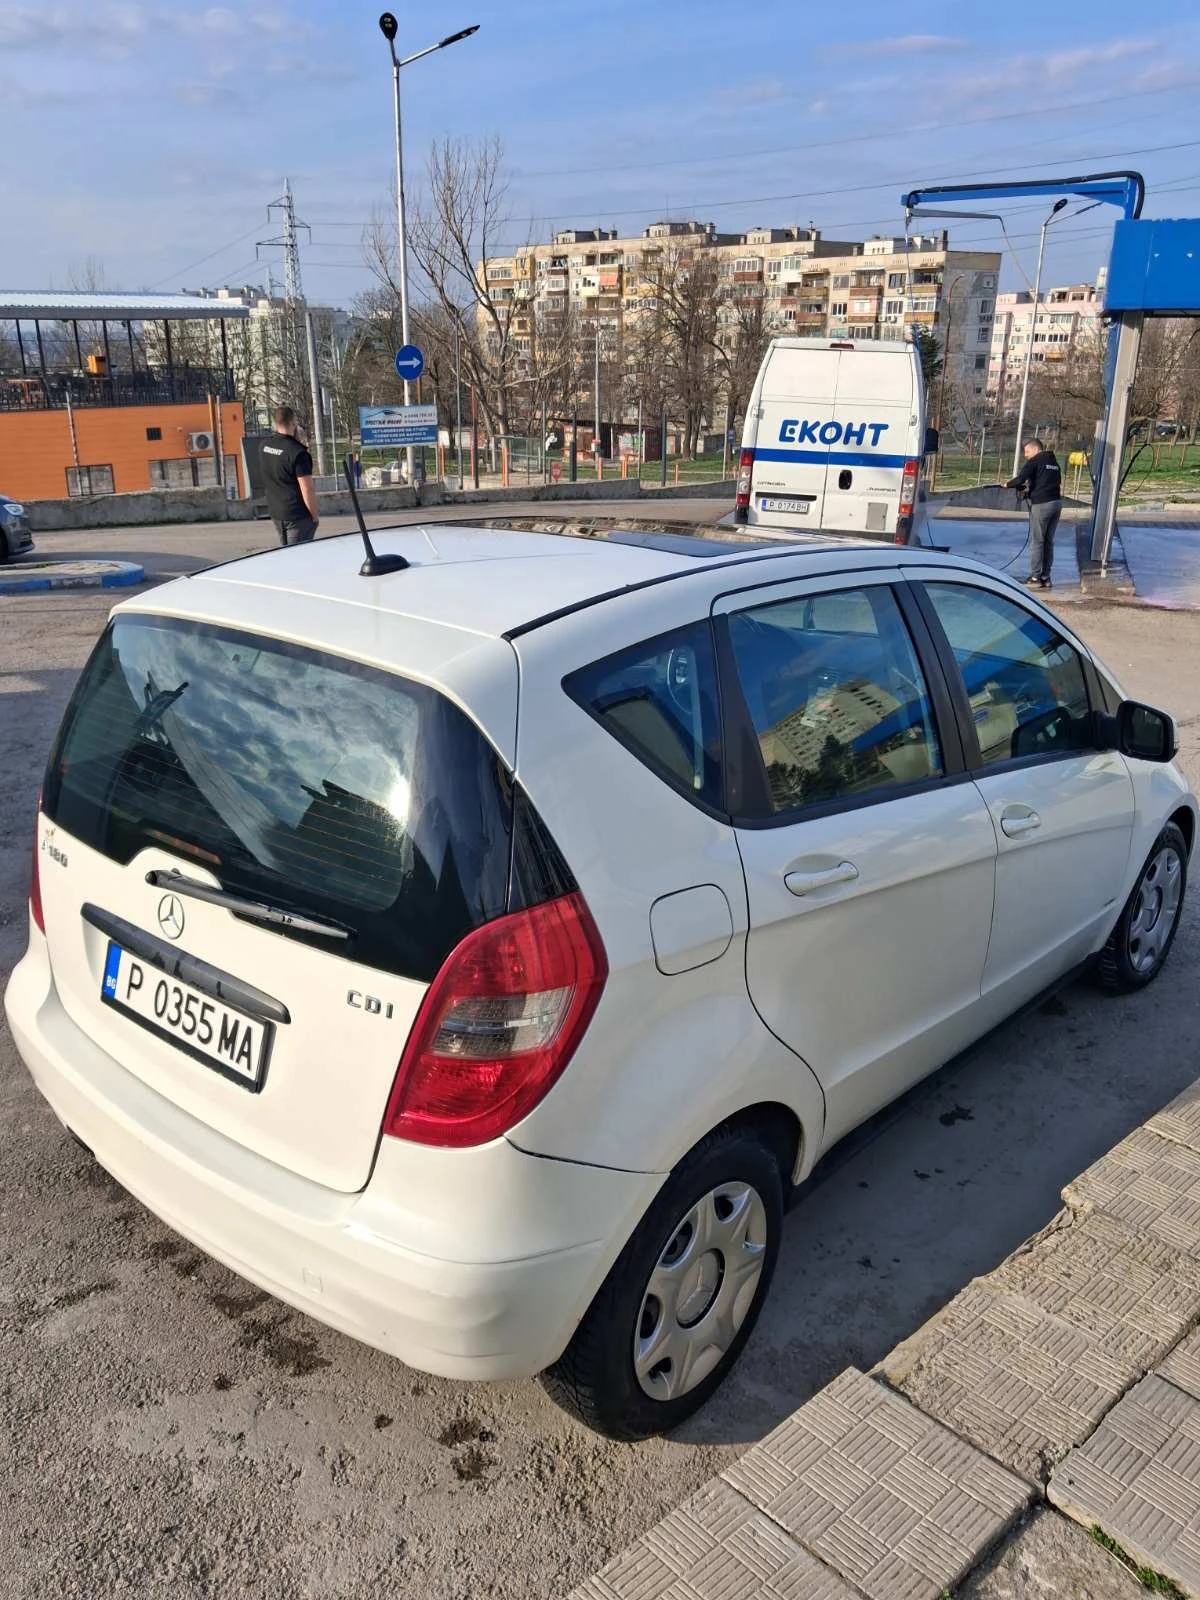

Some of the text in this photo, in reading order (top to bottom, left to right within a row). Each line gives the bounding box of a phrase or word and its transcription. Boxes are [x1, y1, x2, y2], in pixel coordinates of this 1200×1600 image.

[778, 419, 889, 447] ЕКОНТ
[106, 975, 117, 990] BG
[126, 962, 252, 1071] P 0355 MA
[346, 989, 394, 1019] CDI
